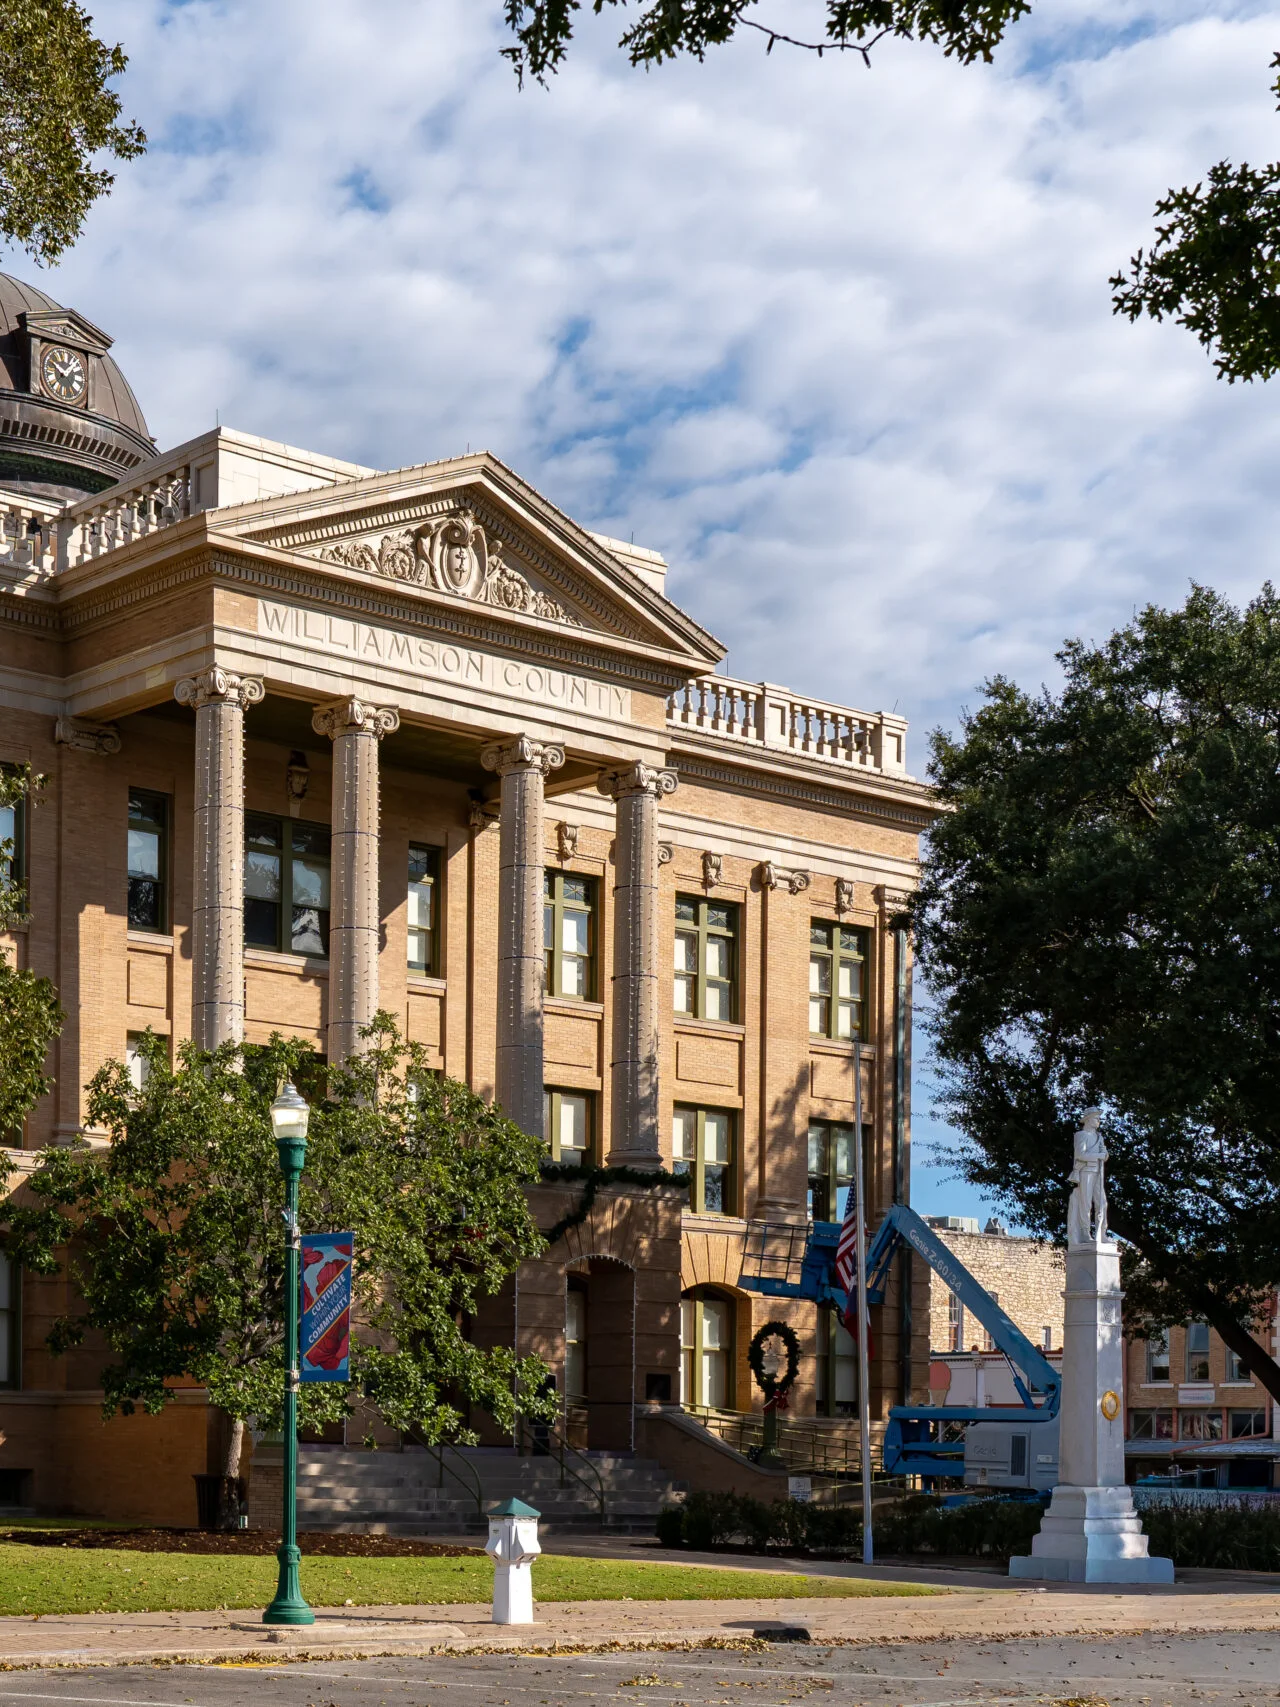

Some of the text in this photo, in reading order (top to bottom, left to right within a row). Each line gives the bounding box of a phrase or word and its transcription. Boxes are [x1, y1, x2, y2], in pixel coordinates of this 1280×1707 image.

[261, 601, 630, 717] WILLIAMSON COUNTY
[910, 1229, 929, 1255] Genie
[309, 1285, 347, 1330] WITHIN YOUR
[311, 1273, 346, 1316] CULTIVATE
[308, 1294, 349, 1344] COMMUNITY
